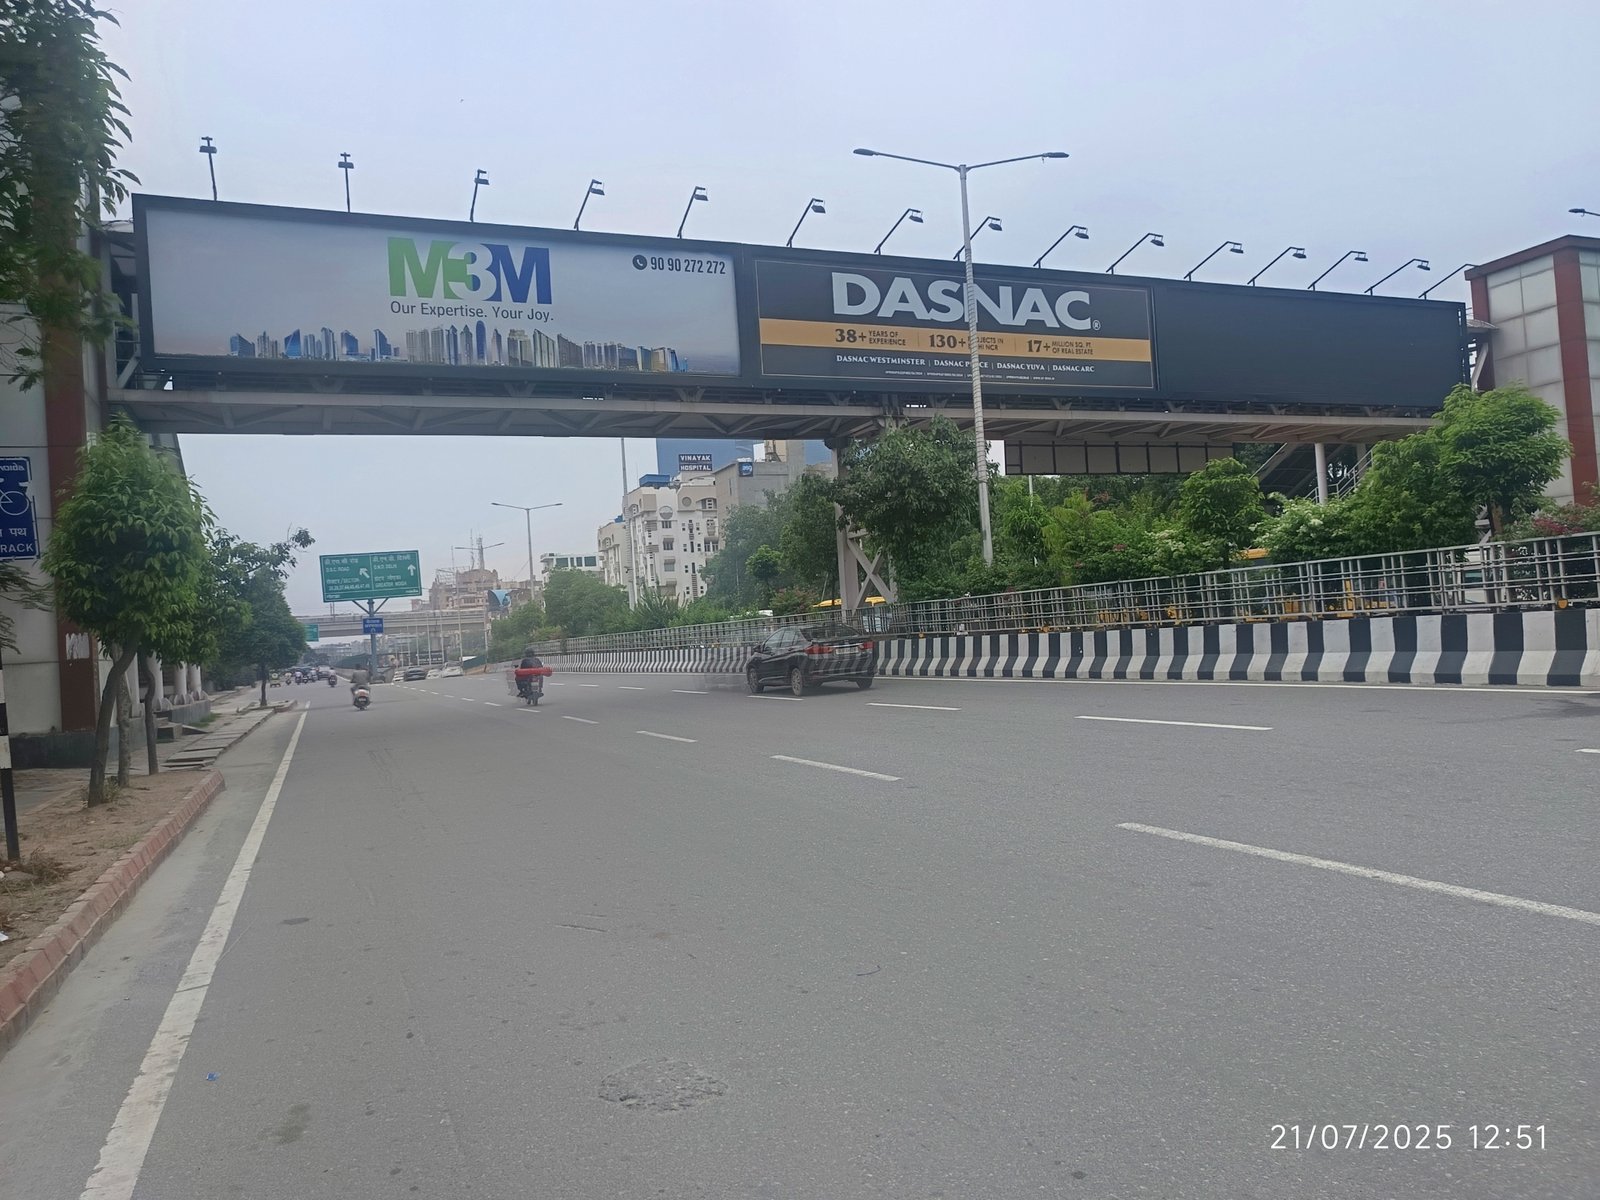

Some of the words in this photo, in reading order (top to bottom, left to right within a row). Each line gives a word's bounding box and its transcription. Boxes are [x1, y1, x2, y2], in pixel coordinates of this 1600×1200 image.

[387, 237, 552, 304] M3M
[650, 256, 664, 271] 90
[667, 257, 681, 272] 90
[684, 258, 704, 273] 272
[706, 260, 726, 275] 272
[831, 272, 1092, 331] DASNAC
[390, 300, 416, 315] Our
[421, 302, 487, 319] Expertise.
[492, 306, 523, 320] Your
[527, 308, 554, 323] Joy.
[835, 328, 867, 343] 38+
[868, 330, 888, 338] YEARS
[929, 334, 966, 348] 130+
[868, 337, 906, 346] EXPERIENCE
[1027, 339, 1051, 353] 17+
[836, 355, 869, 363] DASNAC
[869, 356, 926, 366] WESTMINSTER
